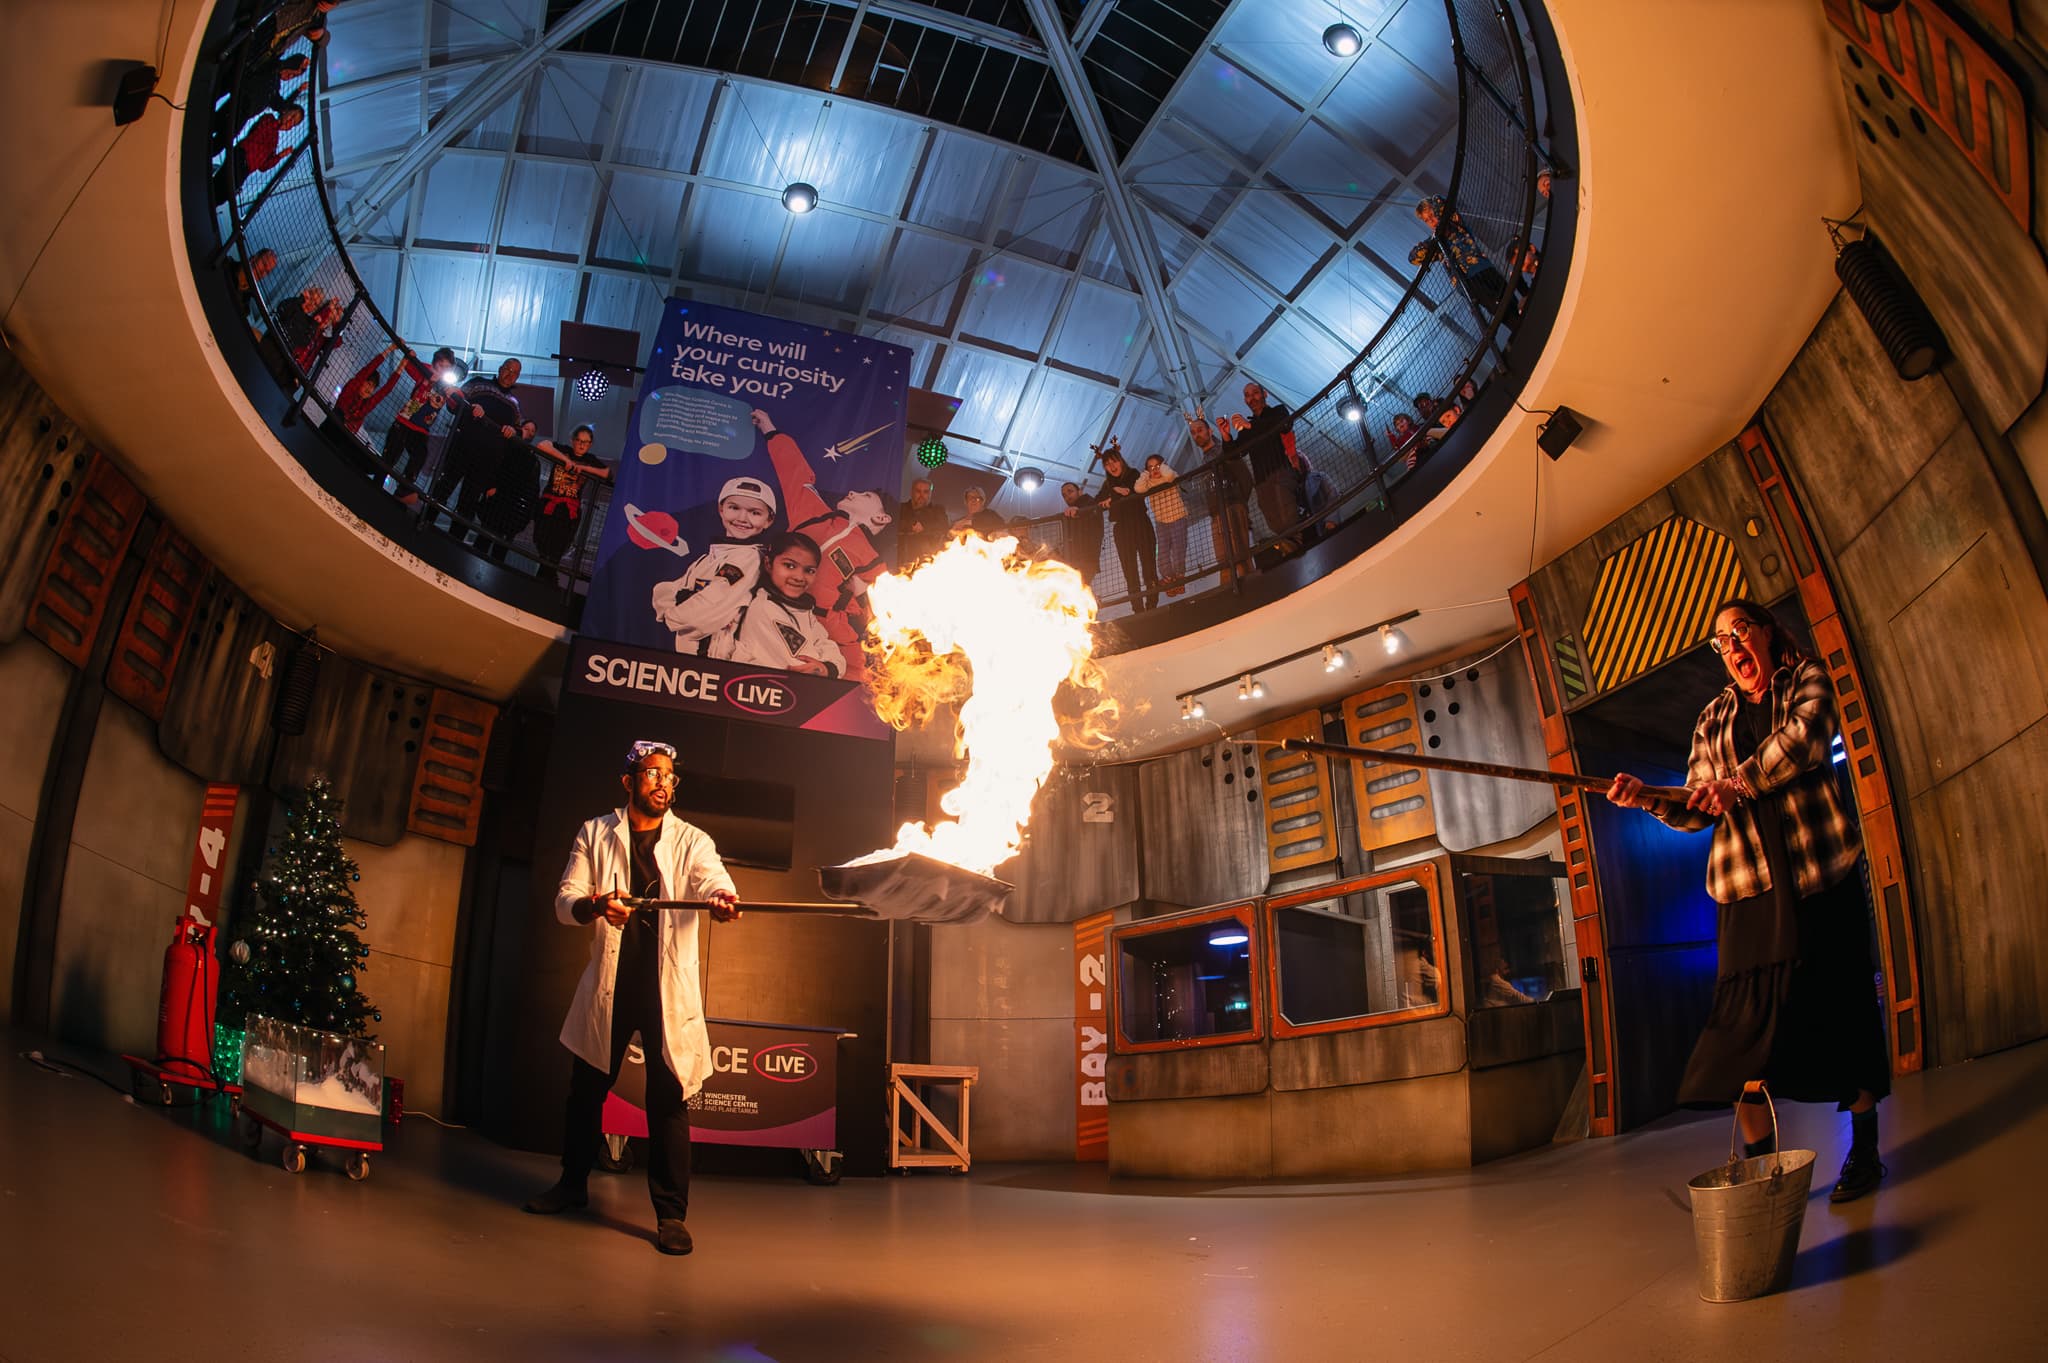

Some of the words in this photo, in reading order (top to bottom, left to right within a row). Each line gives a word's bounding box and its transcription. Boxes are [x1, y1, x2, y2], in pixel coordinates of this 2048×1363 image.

[683, 320, 763, 351] Where
[768, 341, 807, 361] will
[671, 362, 726, 387] take
[729, 375, 794, 400] you?
[673, 344, 734, 367] your
[737, 359, 846, 393] curiosity
[585, 654, 721, 702] SCIENCE
[737, 682, 783, 708] LIVE
[1082, 792, 1114, 823] 2
[765, 1054, 806, 1074] LIVE
[704, 1091, 747, 1101] WINCHESTER
[704, 1098, 732, 1107] SCIENCE
[732, 1100, 759, 1109] CENTRE
